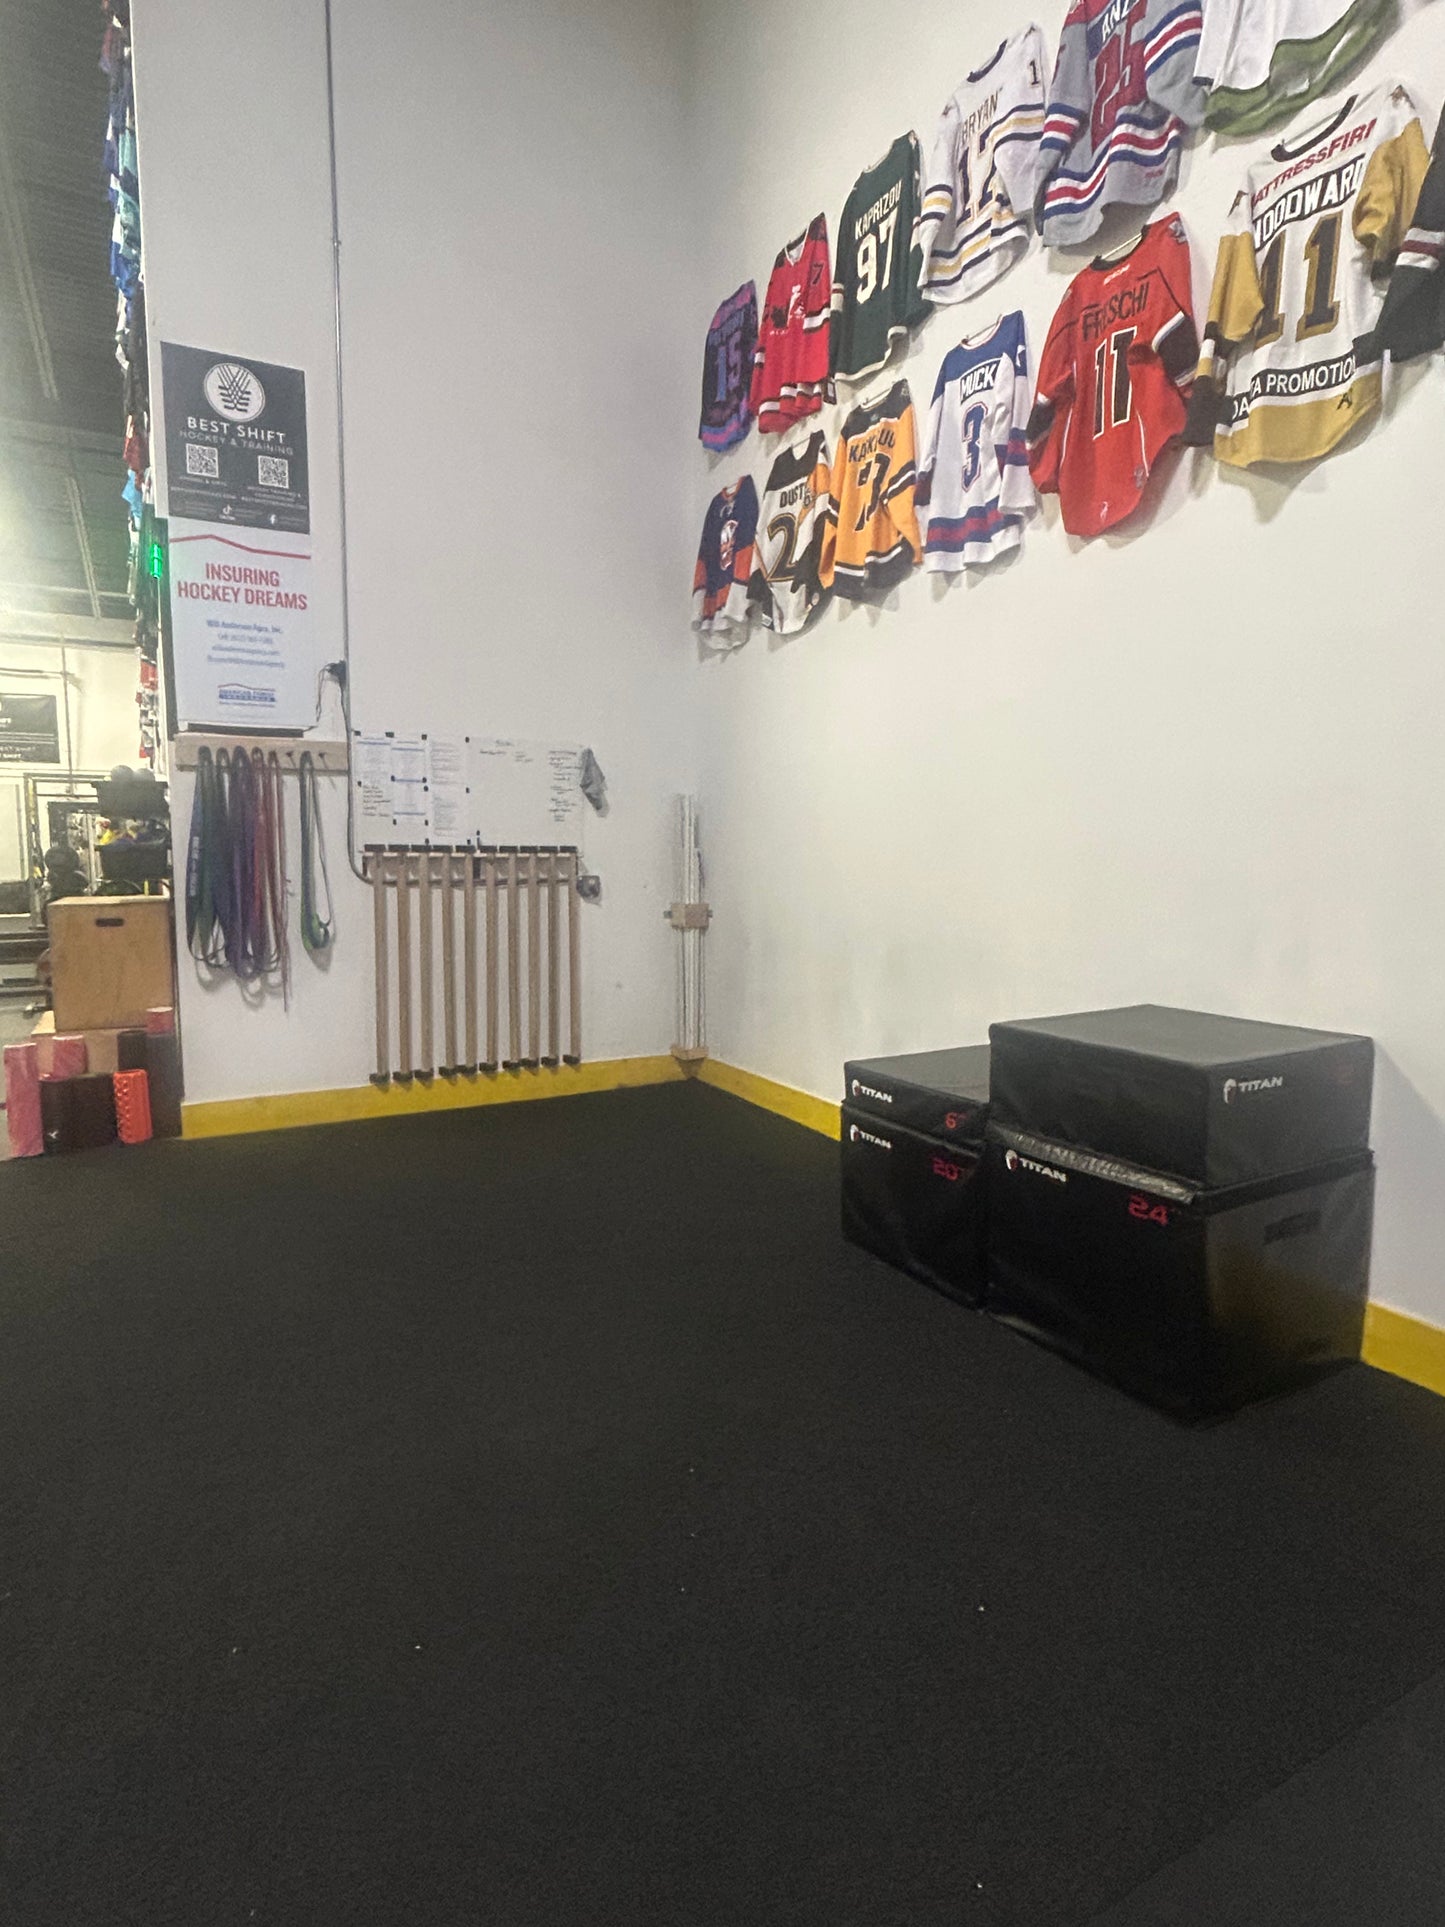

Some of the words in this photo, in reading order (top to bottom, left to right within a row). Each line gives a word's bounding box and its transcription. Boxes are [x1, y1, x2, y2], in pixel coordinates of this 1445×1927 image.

[855, 178, 902, 240] KAPRIZOV
[856, 206, 898, 304] 97
[811, 262, 825, 287] 7
[1092, 325, 1138, 441] 11
[180, 430, 226, 444] HOCKEY
[242, 440, 293, 455] TRAINING
[187, 416, 230, 434] BEST
[236, 425, 286, 444] SHIFT
[205, 562, 280, 587] INSURING
[177, 580, 240, 604] HOCKEY
[244, 588, 308, 611] DREAMS
[860, 1085, 893, 1103] TITAN
[1238, 1076, 1283, 1093] TITAN
[859, 1130, 892, 1149] TITAN
[1019, 1157, 1068, 1182] TITAN
